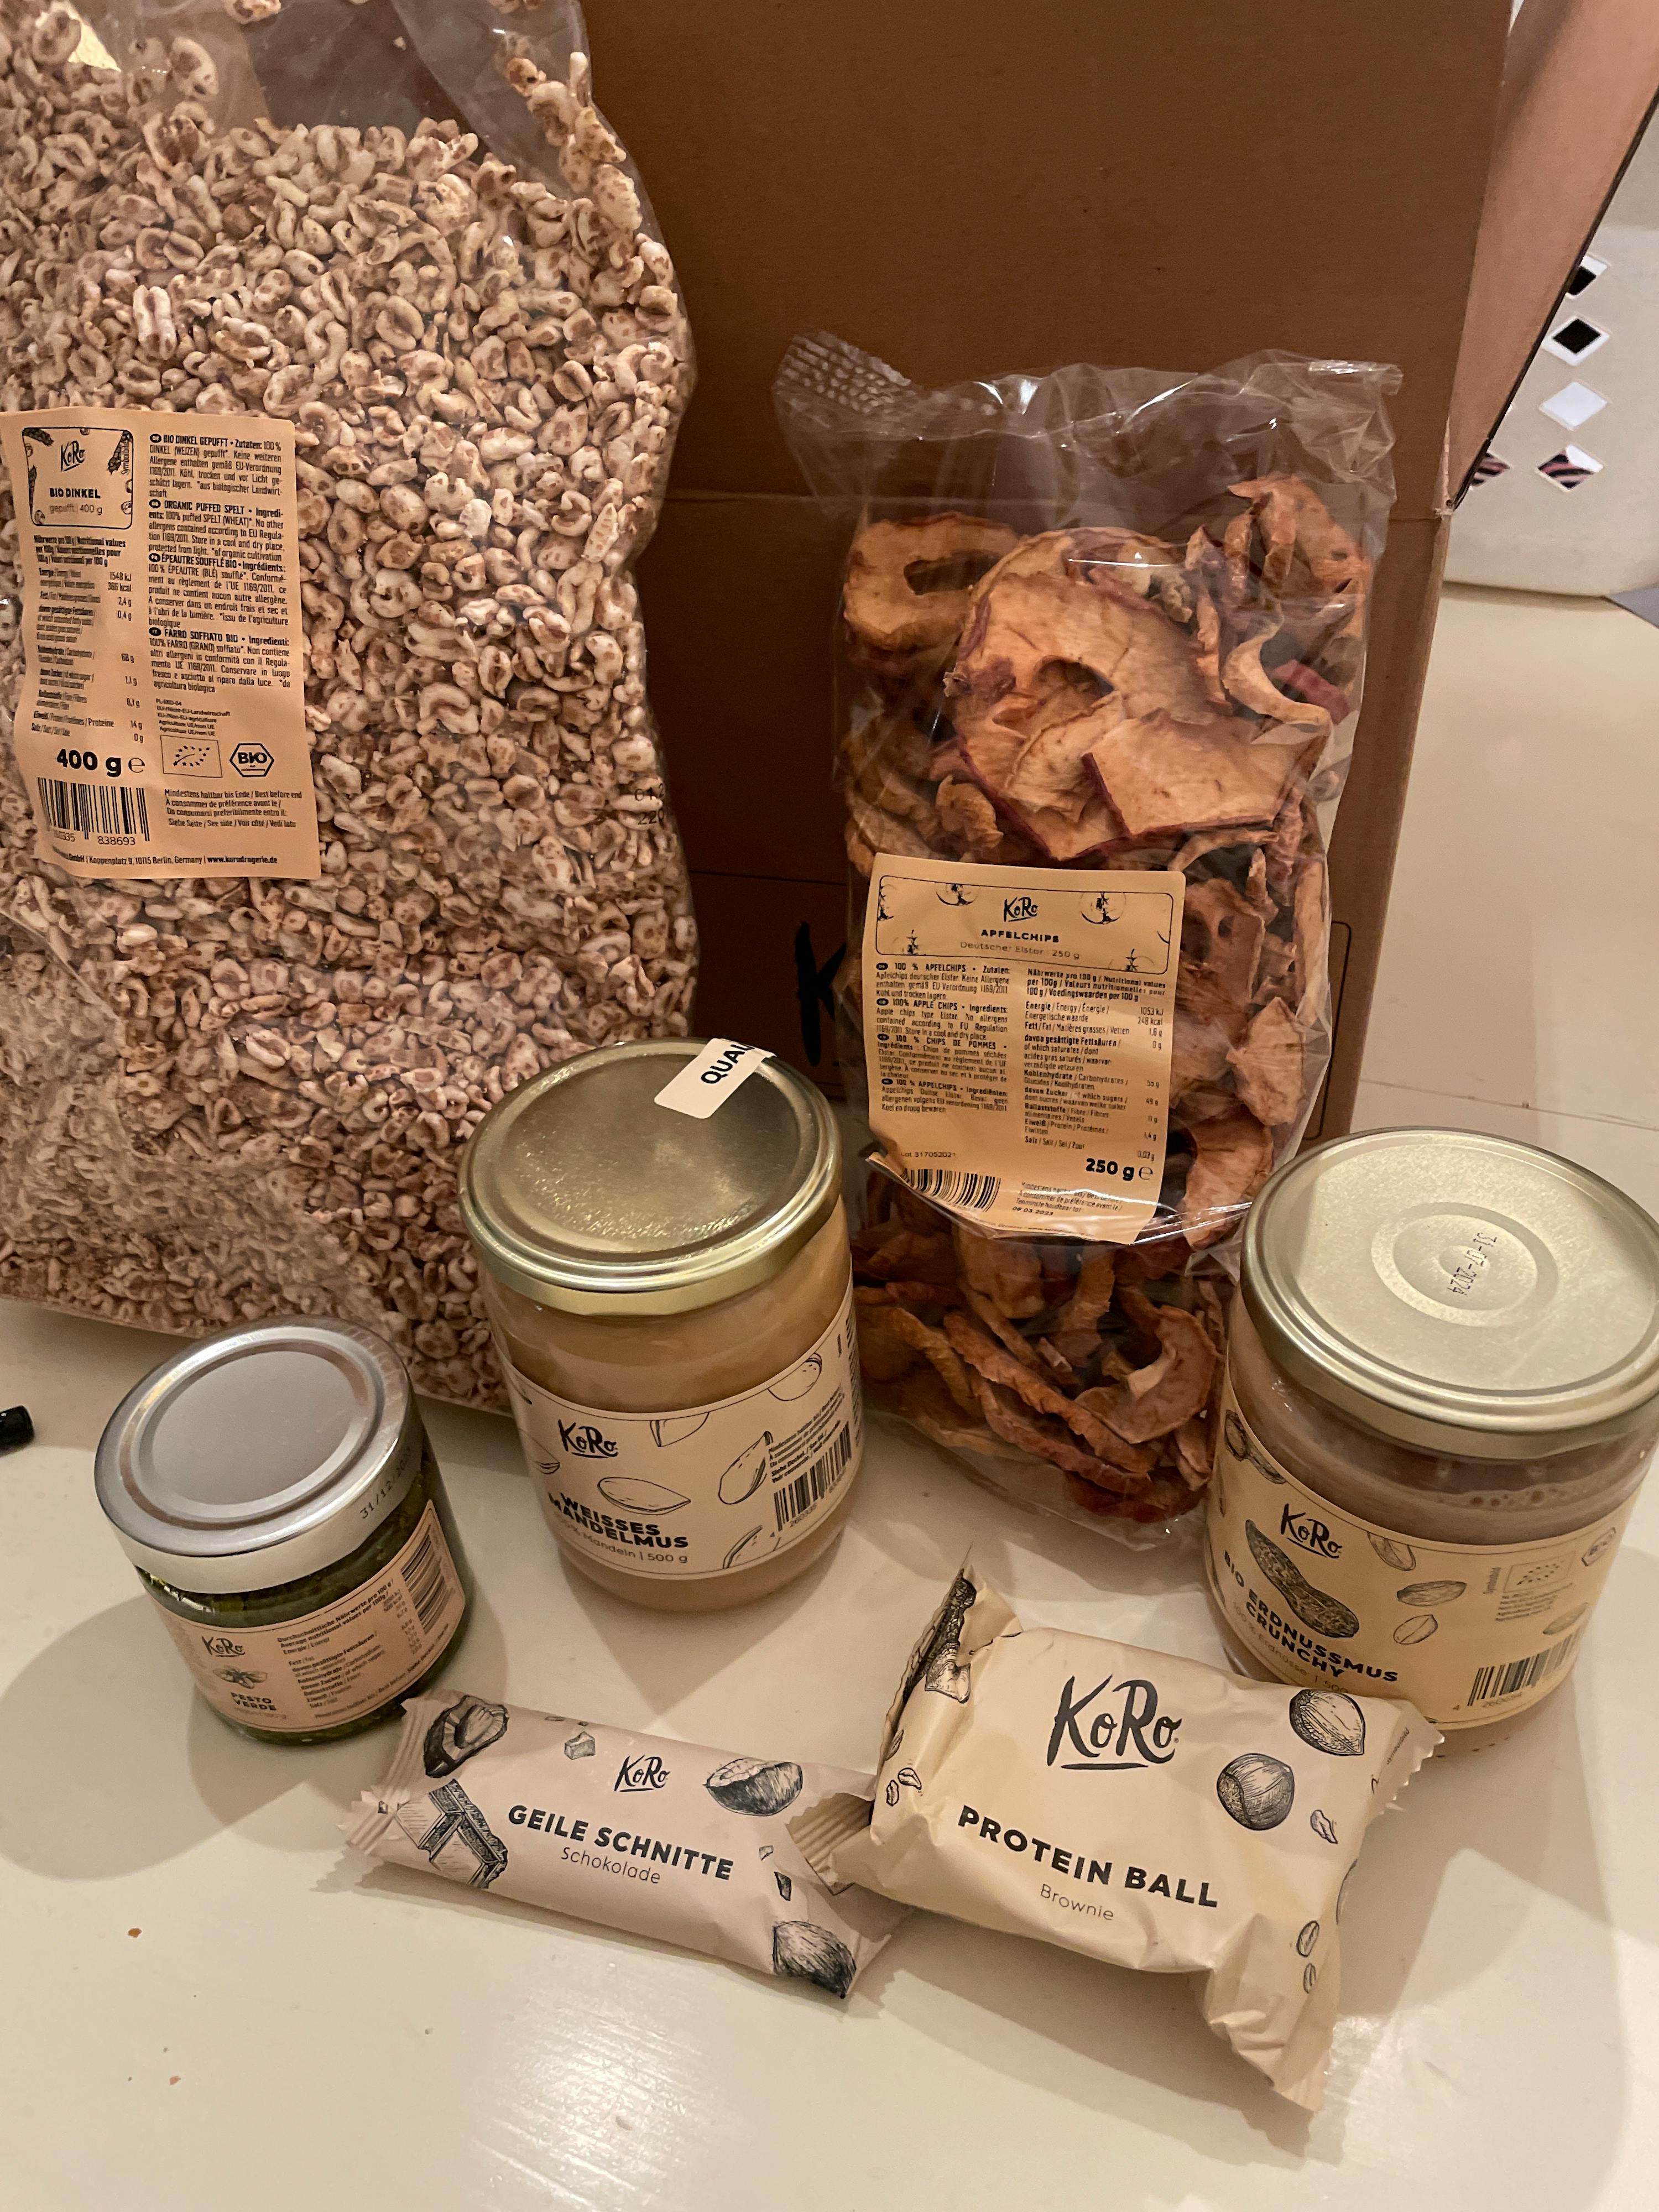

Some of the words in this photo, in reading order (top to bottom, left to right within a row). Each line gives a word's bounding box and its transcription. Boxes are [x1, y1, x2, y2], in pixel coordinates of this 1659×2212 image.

[176, 436, 197, 445] DINKEL
[200, 437, 228, 447] GEPUFFT
[264, 441, 274, 450] 100
[61, 440, 85, 471] KoRo
[150, 445, 171, 454] DINKEL
[175, 446, 200, 457] (WEIZEN)
[234, 451, 250, 459] Keine
[254, 453, 281, 462] weiteren
[150, 456, 177, 466] Allergene
[180, 459, 208, 467] enthalten
[212, 461, 232, 469] gemäß
[50, 488, 63, 497] BIO
[66, 489, 101, 498] DINKEL
[80, 504, 94, 513] 400
[165, 500, 192, 510] ORGANIC
[196, 503, 221, 513] PUFFED
[225, 505, 244, 514] SPELT
[257, 508, 283, 518] Ingredi-
[161, 554, 194, 564] ÉPEAUTRE
[196, 555, 225, 567] SOUFFLÉ
[226, 560, 237, 568] BIO
[243, 561, 286, 573] Ingrédients:
[110, 571, 123, 581] 1548
[120, 583, 131, 592] kcal
[148, 618, 180, 628] biologique
[165, 629, 187, 639] FARRO
[190, 631, 222, 641] SOFFIATO
[226, 634, 238, 643] BIO
[249, 635, 289, 646] Ingredienti:
[154, 681, 186, 690] agricoltura
[189, 683, 215, 693] biologica
[88, 718, 114, 727] Proteine
[131, 720, 137, 728] 14
[57, 749, 98, 770] 400
[106, 757, 121, 777] g
[238, 752, 267, 764] BIO
[165, 789, 199, 798] Mindestens
[98, 836, 135, 845] 838693
[89, 855, 127, 865] Koppenplatz
[175, 856, 202, 864] Germany
[1004, 896, 1038, 922] KoRo
[981, 929, 1059, 942] APFELCHIPS
[961, 942, 1011, 952] Deutscher
[1016, 946, 1044, 954] Elstar
[925, 964, 966, 972] APFELCHIPS
[914, 1000, 933, 1008] APPLE
[1026, 1001, 1051, 1011] Energie
[1056, 1003, 1077, 1013] Energy
[1141, 1007, 1155, 1015] 1053
[1025, 1021, 1037, 1030] Fett
[1042, 1022, 1051, 1031] Fat
[969, 1040, 995, 1050] POMMES
[919, 1081, 957, 1091] APPELCHIPS
[1086, 1158, 1118, 1175] 250
[1123, 1167, 1134, 1181] g
[557, 1419, 618, 1458] KoRo
[548, 1491, 688, 1548] MANDELMUS
[561, 1492, 660, 1535] WEISSES
[1280, 1503, 1343, 1559] KoRo
[648, 1553, 673, 1562] 500
[1224, 1550, 1245, 1587] BIO
[1249, 1588, 1399, 1682] ERDNUSSMUS
[202, 1636, 246, 1657] KoRo
[1246, 1601, 1344, 1678] CRUNCHY
[231, 1692, 272, 1703] PESTO
[232, 1698, 276, 1710] VERDE
[1047, 1674, 1182, 1770] KoRo
[614, 1754, 670, 1792] KoRo
[508, 1804, 589, 1841] GEILE
[594, 1827, 734, 1881] SCHNITTE
[958, 1805, 1113, 1885] PROTEIN
[1124, 1866, 1218, 1908] BALL
[561, 1846, 661, 1885] Schokolade
[1040, 1883, 1115, 1921] Brownie
